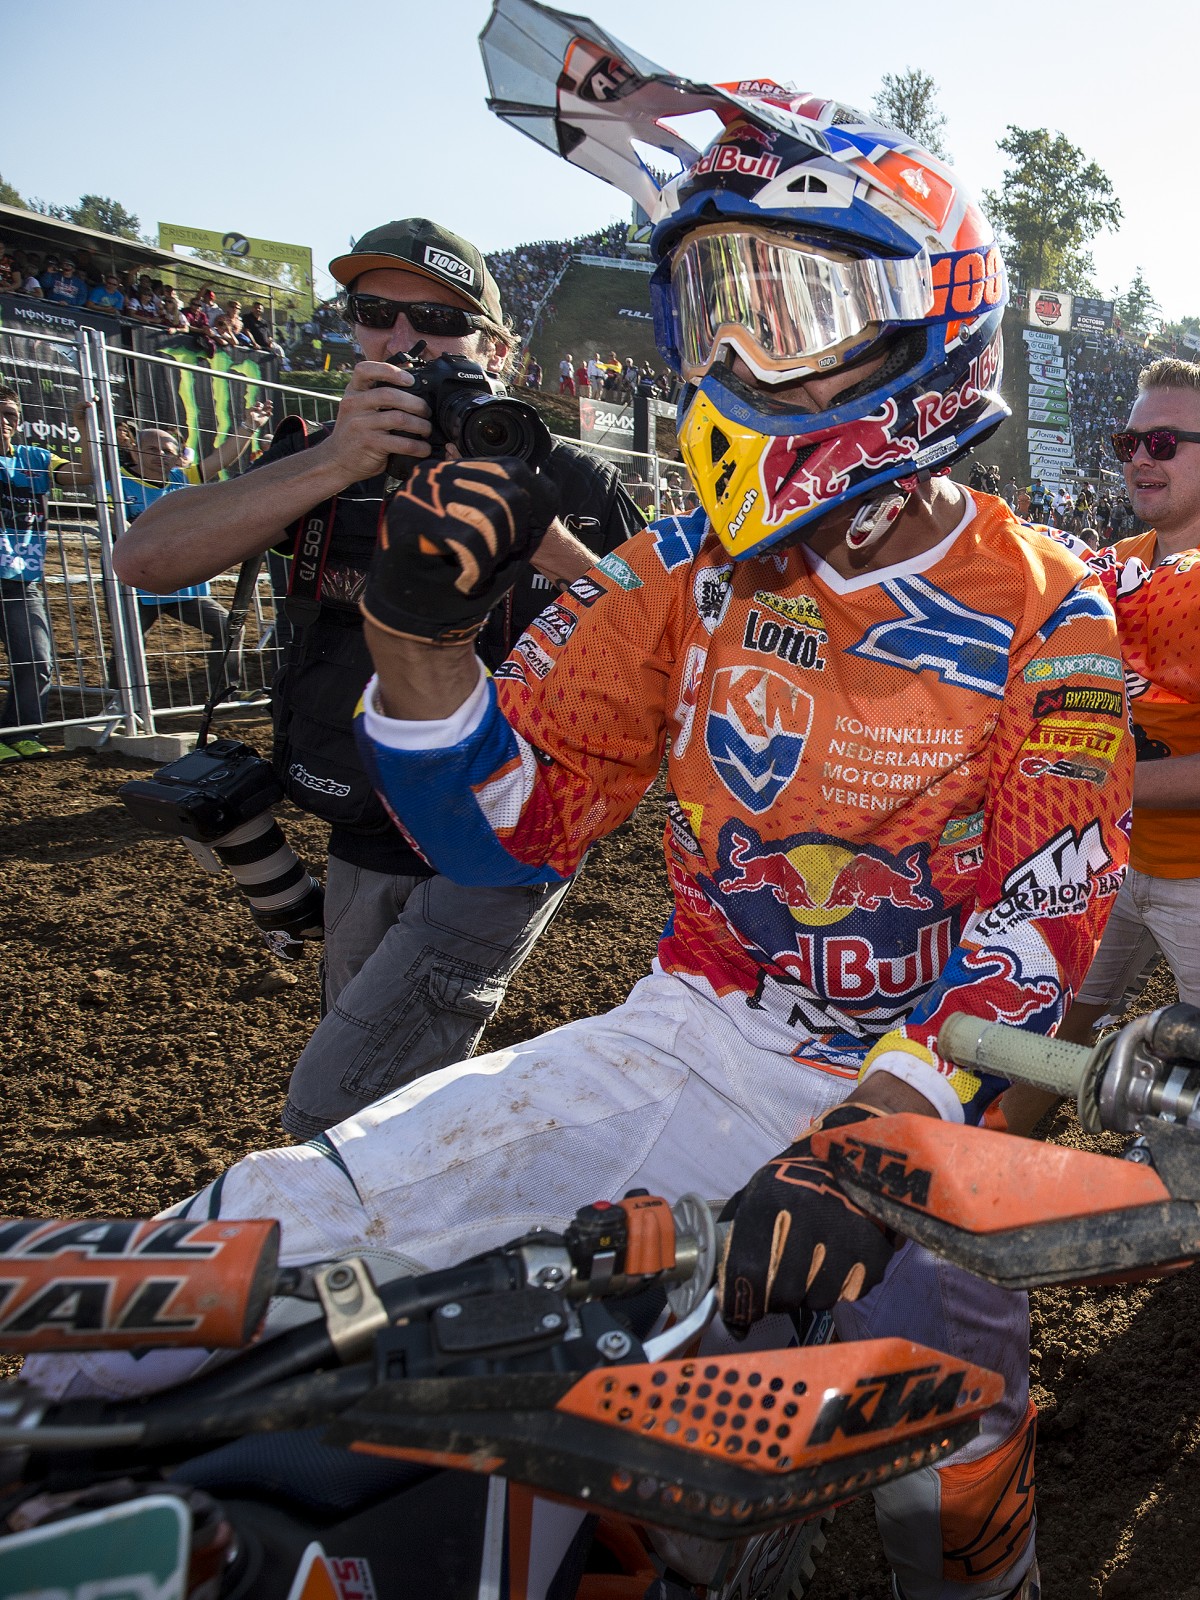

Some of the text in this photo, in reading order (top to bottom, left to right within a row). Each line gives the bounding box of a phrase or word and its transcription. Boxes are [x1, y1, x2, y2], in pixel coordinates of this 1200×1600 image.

[715, 146, 782, 180] Bull
[161, 226, 210, 242] CRISTINA
[261, 243, 309, 258] CRISTINA
[430, 252, 469, 280] 100%
[14, 307, 77, 328] MONSTER
[1035, 332, 1054, 341] CALEFFI
[457, 371, 484, 380] Canon
[912, 358, 979, 441] Red
[594, 410, 635, 430] 24MX
[727, 488, 758, 540] Airoh
[299, 518, 324, 581] EOS 7D
[1053, 657, 1121, 676] MOTOREX
[834, 714, 964, 745] KONINKLIJKE
[974, 880, 1094, 938] SCORPION
[1097, 866, 1127, 897] BAY
[823, 916, 953, 999] Bull
[813, 1136, 933, 1208] KTM
[806, 1365, 972, 1448] KTM
